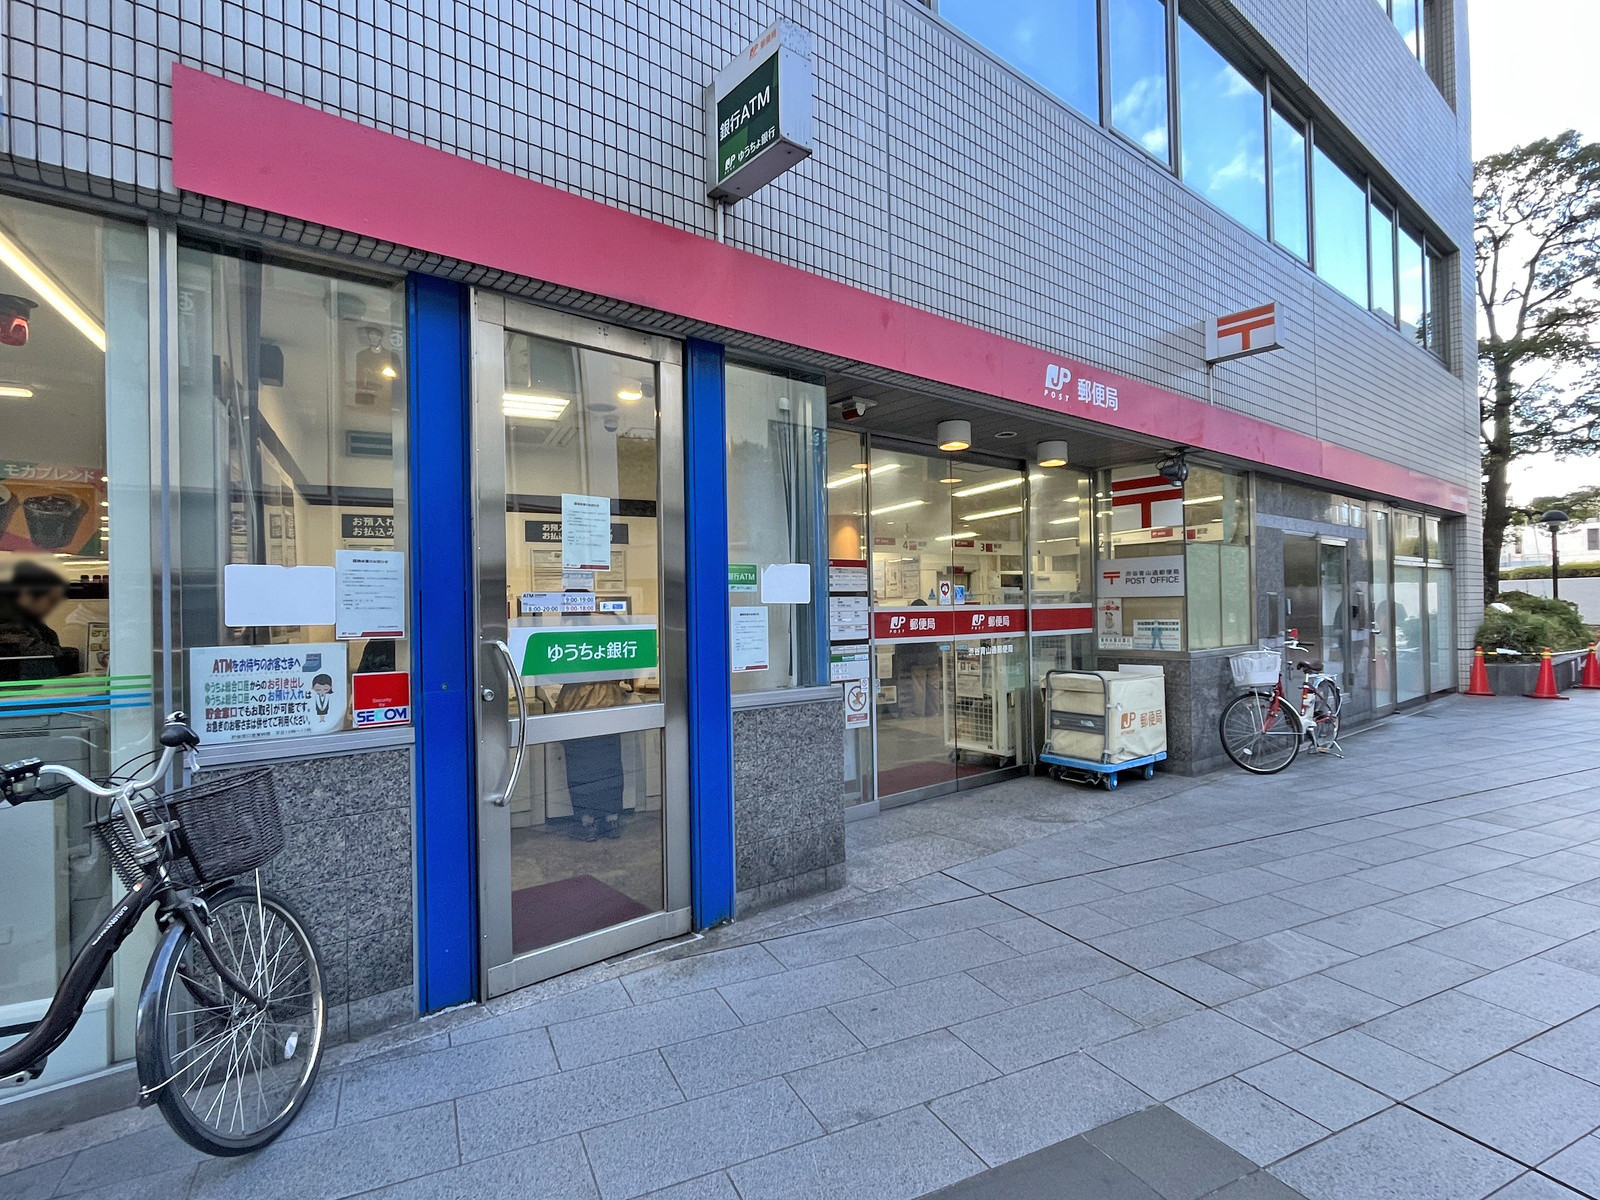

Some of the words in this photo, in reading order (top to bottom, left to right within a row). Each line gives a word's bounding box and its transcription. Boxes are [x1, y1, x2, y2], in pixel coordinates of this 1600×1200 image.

[719, 85, 770, 141] 銀行ATM
[737, 125, 776, 162] ゆうちょ銀行
[1043, 389, 1070, 402] POST
[1077, 378, 1118, 411] 郵便局
[1125, 576, 1146, 585] POST
[1150, 575, 1180, 584] OFFICE
[909, 617, 936, 631] 郵便局
[987, 615, 1010, 627] 郵便局
[547, 641, 637, 662] ゆうちょ銀行
[212, 657, 301, 674] ATMをお待ちのお客さまへ
[356, 707, 407, 724] SECOM
[1140, 709, 1163, 729] 郵便局
